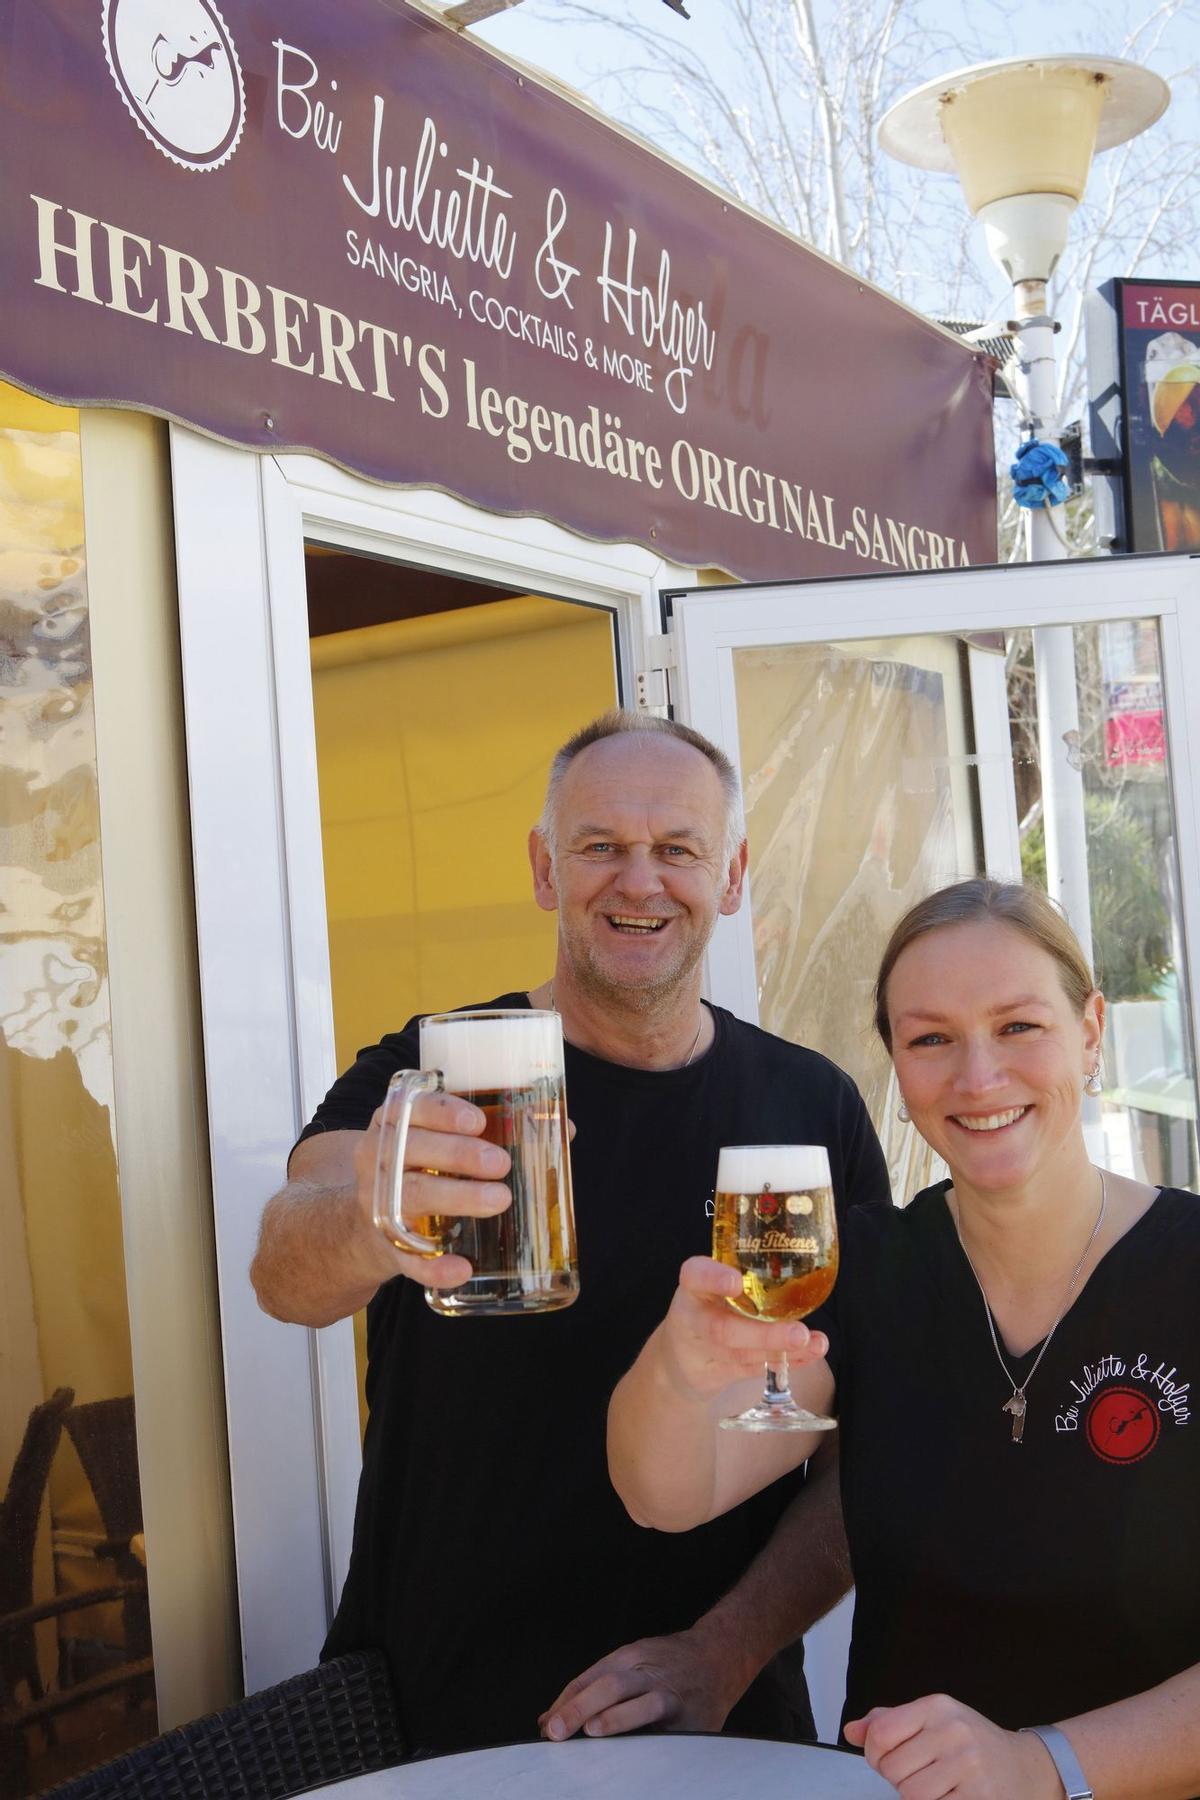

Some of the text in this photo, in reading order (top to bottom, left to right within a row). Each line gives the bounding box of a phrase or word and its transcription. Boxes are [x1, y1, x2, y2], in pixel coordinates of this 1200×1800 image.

[272, 38, 342, 154] Bei
[343, 96, 516, 279] Juliette
[535, 188, 581, 310] &
[597, 221, 716, 414] Holger
[30, 194, 449, 419] HERBERT'S
[463, 358, 663, 489] legendäre
[346, 230, 654, 393] SANGRIA, COCKTAILS & MORE
[1136, 296, 1200, 326] TÄGL
[1055, 1353, 1192, 1432] Bei Juliette & Holger
